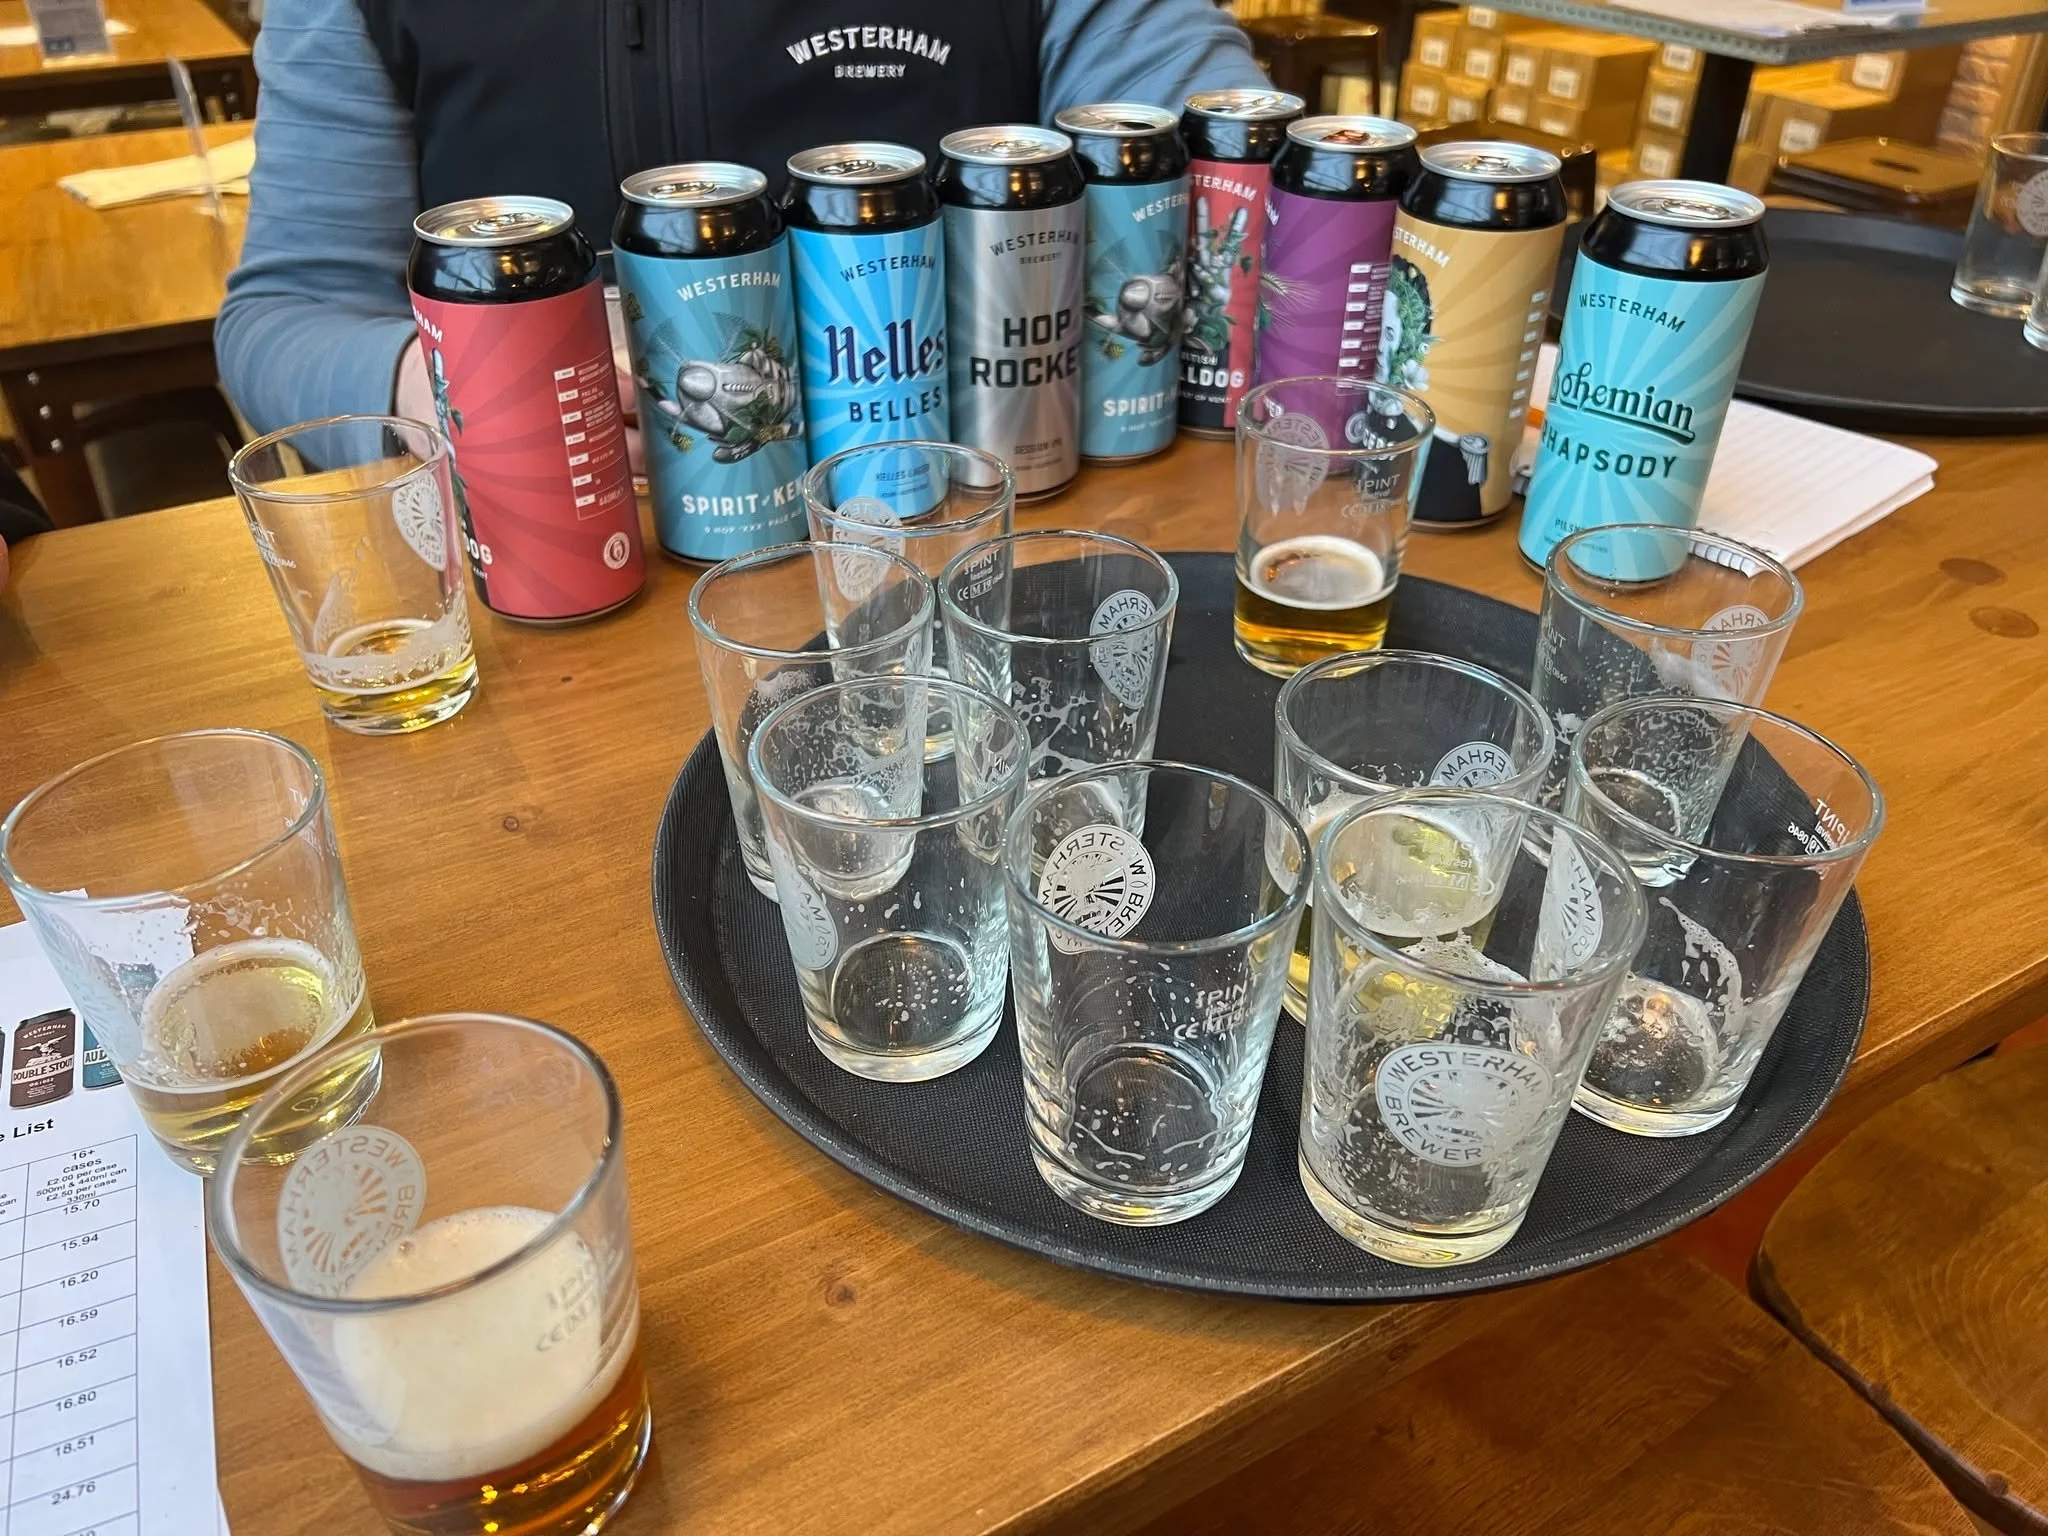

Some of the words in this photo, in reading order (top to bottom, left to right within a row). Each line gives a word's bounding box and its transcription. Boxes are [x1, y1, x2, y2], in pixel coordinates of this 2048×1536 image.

[786, 26, 951, 66] WESTERHAM
[834, 64, 906, 78] BREWERY
[840, 255, 937, 283] WESTERHAM
[676, 271, 781, 302] WESTERHAM
[1579, 293, 1686, 333] WESTERHAM
[1003, 308, 1071, 347] HOP
[823, 318, 945, 387] Helles
[969, 346, 1078, 389] ROCKE
[1553, 352, 1694, 433] ohemian
[848, 386, 941, 423] BELLES
[1103, 392, 1165, 417] SPIRIT
[681, 493, 759, 517] SPIRIT
[13, 1118, 55, 1139] List
[1386, 1095, 1482, 1161] BREWER
[71, 1148, 96, 1161] 16+
[62, 1158, 103, 1174] cases
[76, 1168, 92, 1180] per
[94, 1163, 118, 1174] case
[110, 1167, 128, 1177] can
[76, 1184, 92, 1195] per
[94, 1178, 118, 1189] case
[62, 1198, 100, 1216] 15.70
[61, 1233, 99, 1251] 15.94
[59, 1270, 99, 1289] 16.20
[58, 1308, 98, 1328] 16.59
[56, 1348, 97, 1369] 16.52
[55, 1390, 97, 1412] 16.80
[55, 1435, 95, 1457] 18.51
[51, 1481, 97, 1505] 24.76
